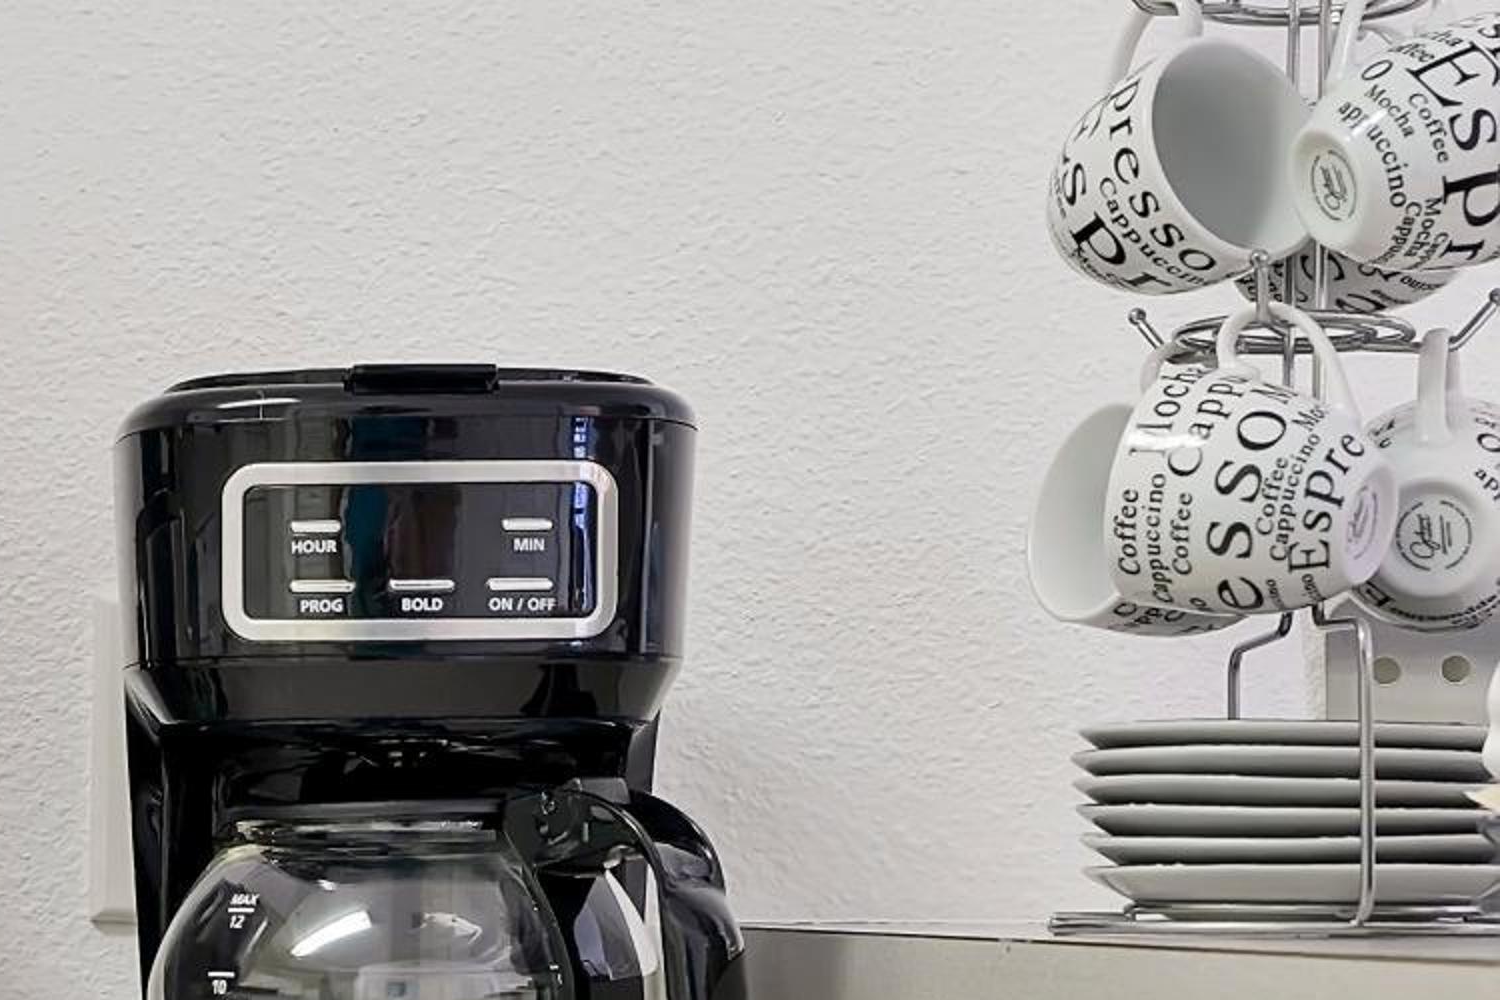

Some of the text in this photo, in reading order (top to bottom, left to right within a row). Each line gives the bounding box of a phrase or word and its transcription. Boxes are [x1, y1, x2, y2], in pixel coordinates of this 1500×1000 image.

[1364, 84, 1415, 138] Mocha
[1408, 92, 1451, 163] Coffee
[1403, 197, 1446, 258] Mocha
[1255, 456, 1289, 536] Coffee
[1270, 433, 1321, 562] Cappuccino
[1286, 433, 1365, 574] Espre
[291, 540, 337, 554] HOUR
[513, 538, 545, 552] MIN
[1113, 489, 1141, 575] Coffee
[1141, 473, 1174, 603] Cappuccino
[1170, 492, 1193, 576] Coffee
[300, 599, 343, 613] PROG
[401, 598, 443, 612] BOLD
[488, 598, 556, 613] ON / OFF
[229, 914, 246, 929] 12
[230, 893, 260, 906] MAX
[211, 979, 228, 995] 10
